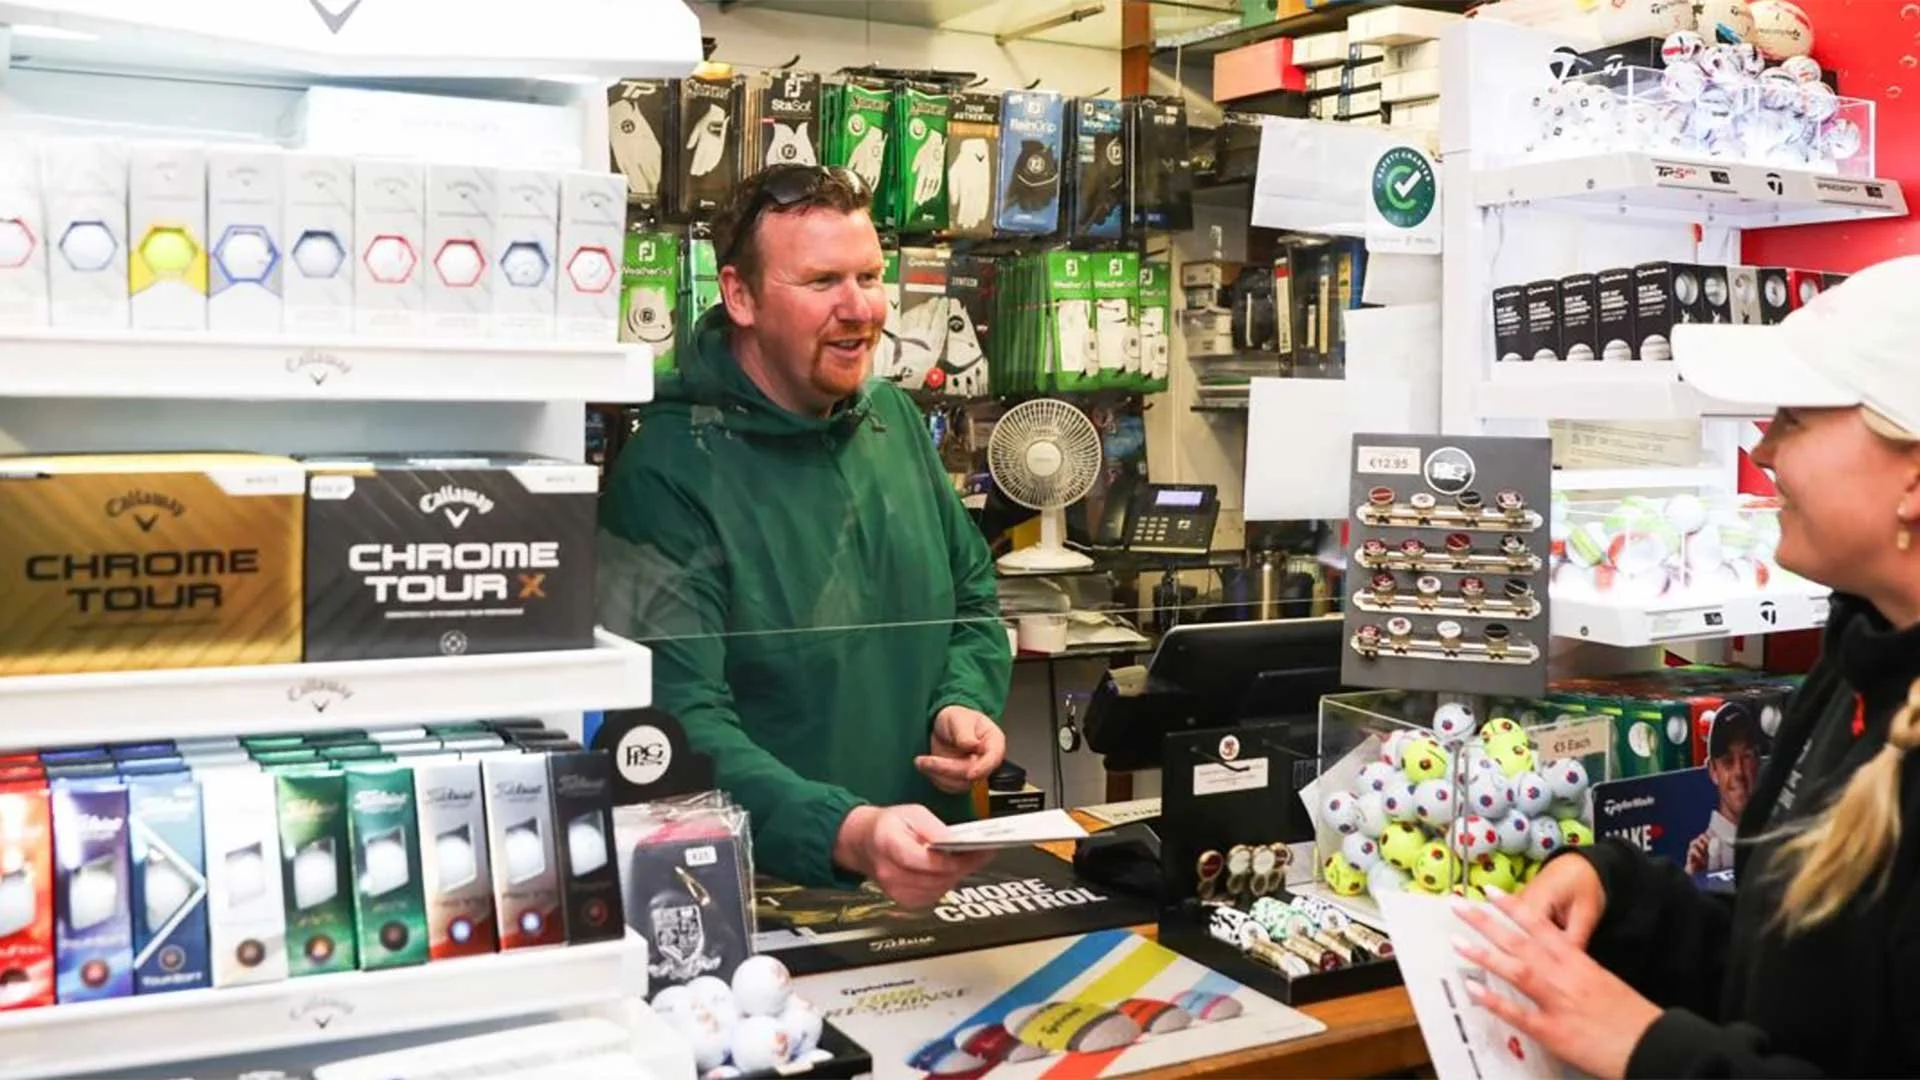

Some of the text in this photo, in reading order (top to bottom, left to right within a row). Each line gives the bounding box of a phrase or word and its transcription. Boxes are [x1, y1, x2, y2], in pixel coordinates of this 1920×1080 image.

[619, 80, 657, 99] TP
[784, 78, 801, 98] FJ
[771, 98, 812, 112] StaSof
[638, 240, 656, 262] FJ
[1369, 457, 1409, 470] €12.95
[104, 487, 186, 518] Callaway
[418, 485, 495, 515] Callaway
[25, 548, 260, 581] CHROME
[349, 541, 560, 571] CHROME
[67, 582, 222, 612] TOUR
[364, 572, 546, 603] TOUR X
[1567, 737, 1592, 751] Each
[933, 887, 1109, 923] CONTROL
[942, 877, 1053, 906] MORE
[841, 979, 915, 996] TaylorMade
